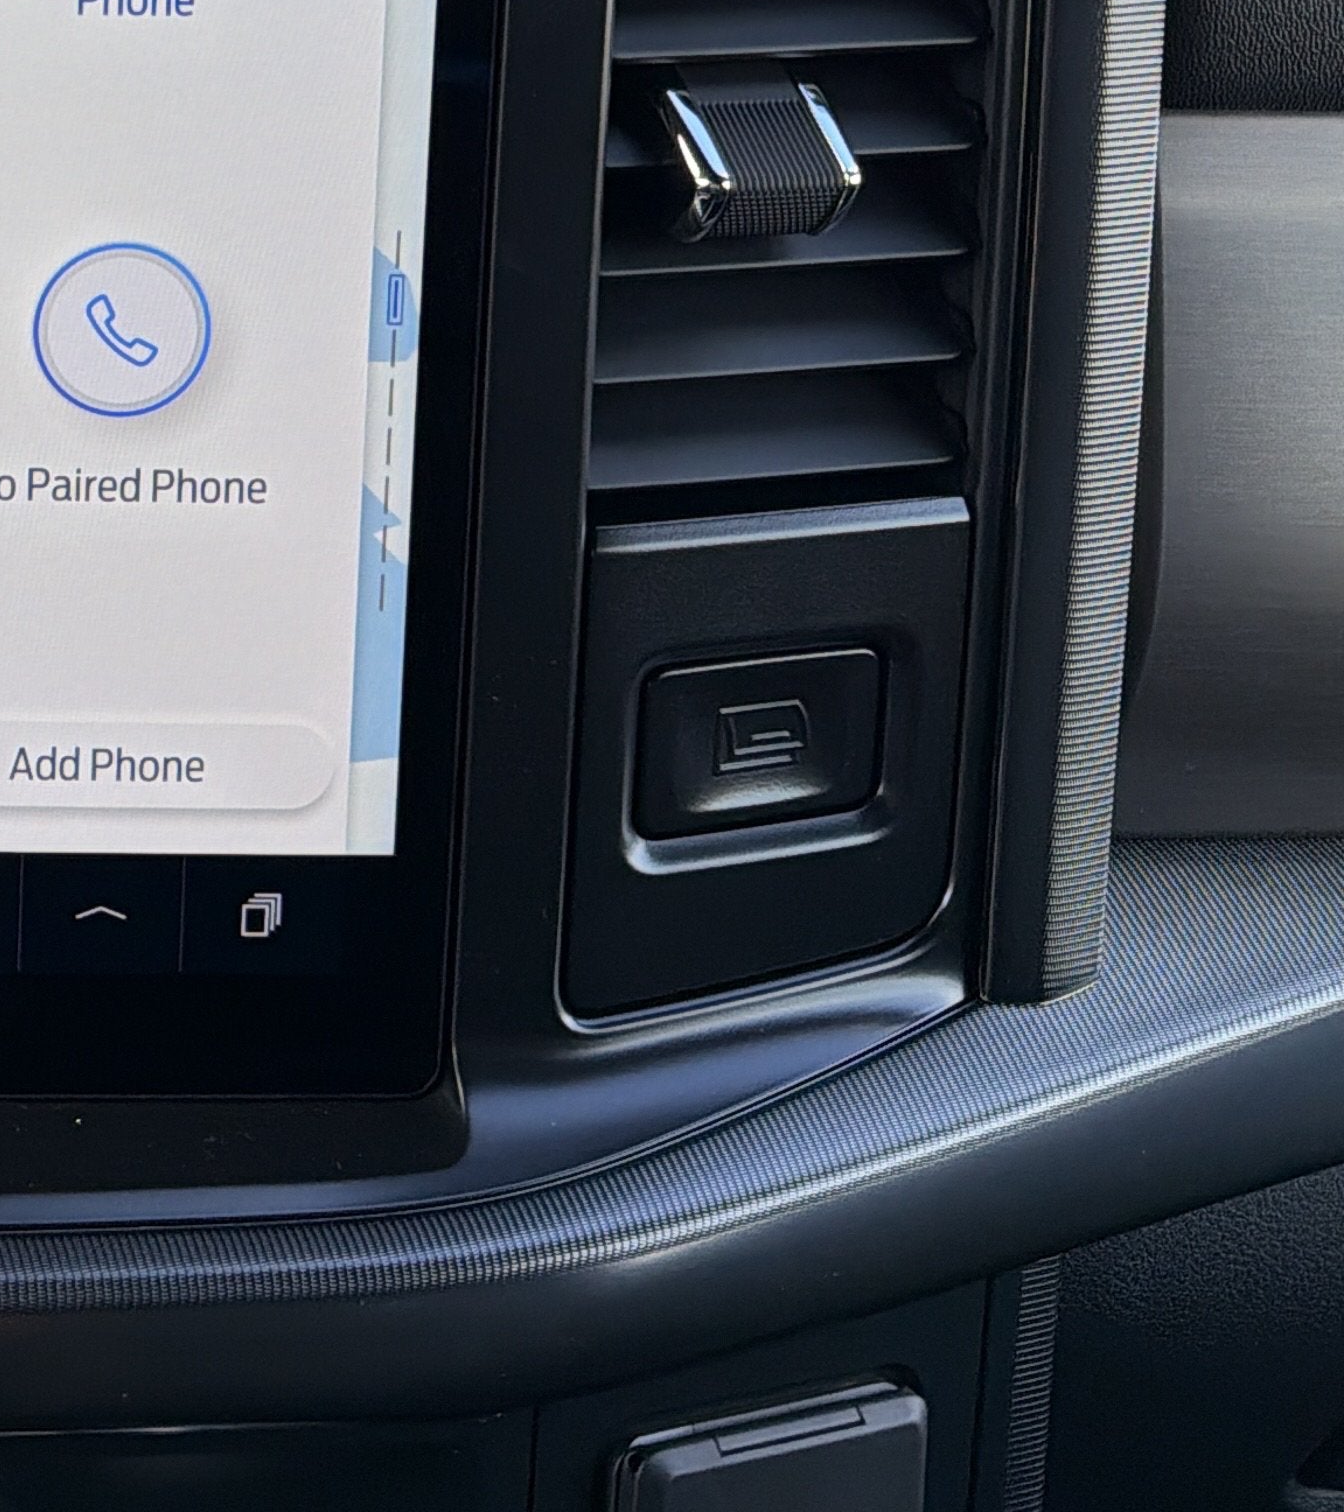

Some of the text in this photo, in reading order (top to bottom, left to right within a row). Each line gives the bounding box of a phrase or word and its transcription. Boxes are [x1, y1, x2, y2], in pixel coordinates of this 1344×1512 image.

[25, 466, 142, 504] Paired
[150, 468, 269, 505] Phone
[9, 746, 207, 783] Add Phone
